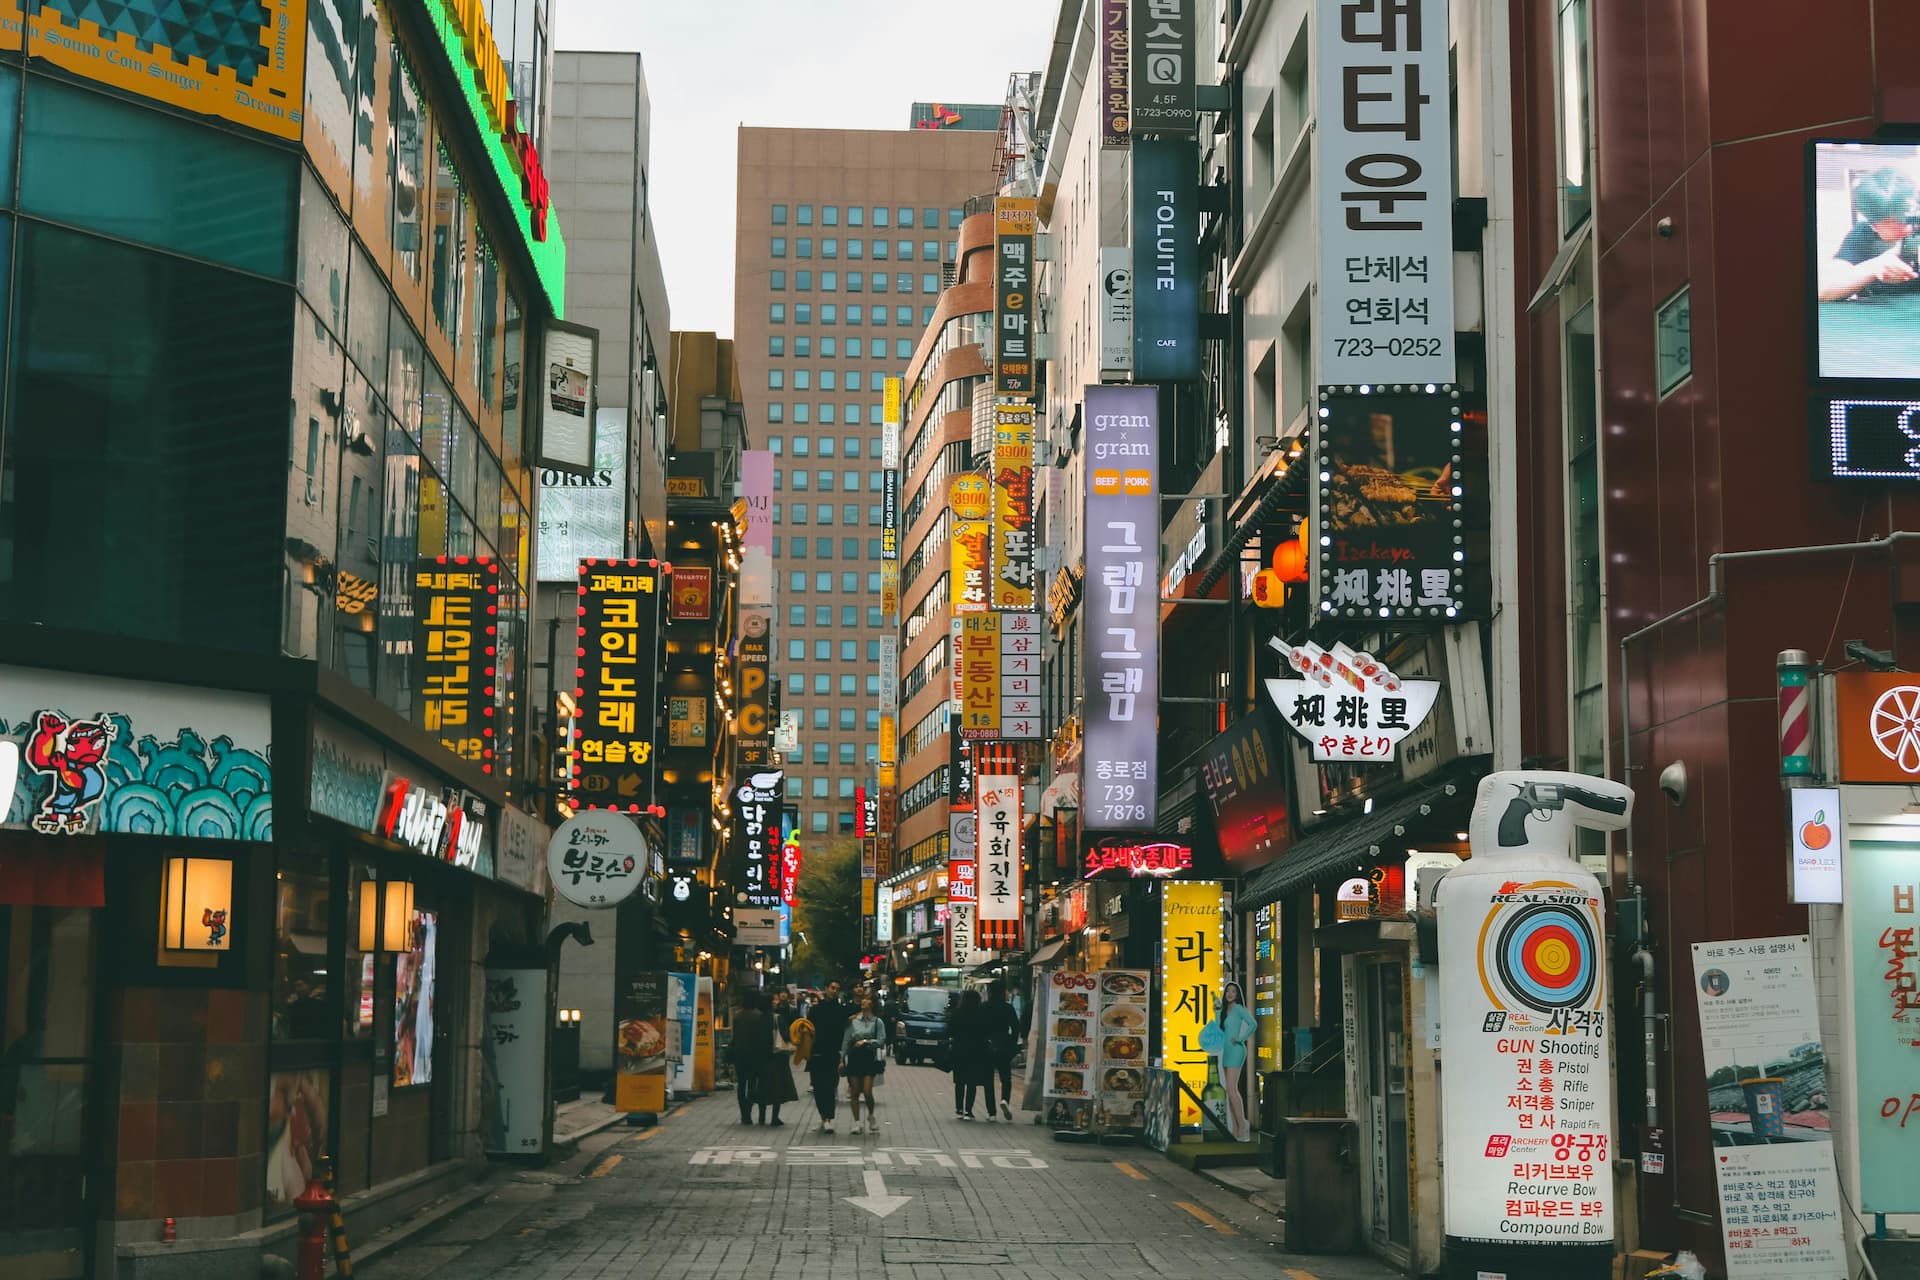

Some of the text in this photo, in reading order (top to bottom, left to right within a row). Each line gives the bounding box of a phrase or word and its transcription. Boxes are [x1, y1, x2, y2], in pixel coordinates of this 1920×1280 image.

[1156, 190, 1175, 290] FOLUITE
[1345, 256, 1428, 284] 단체석
[1345, 298, 1429, 325] 연회석
[1156, 339, 1177, 347] CAFE
[1334, 338, 1442, 357] 723-0252
[1095, 414, 1151, 431] gram
[998, 446, 1029, 457] 3900
[1095, 442, 1151, 459] gram
[1096, 477, 1149, 486] BEEF PORK
[954, 492, 986, 504] 3900
[590, 574, 654, 593] 고래고래
[1101, 521, 1143, 721] 그램그램
[598, 598, 639, 733] 코인노래
[741, 654, 768, 662] SPEED
[967, 635, 996, 709] 부동산
[582, 740, 652, 764] 연습장
[1319, 735, 1391, 756] やきとり
[1096, 761, 1147, 780] 종로점
[1104, 785, 1135, 801] 739
[1096, 805, 1146, 821] -7878
[989, 810, 1012, 904] 육회지존
[1170, 902, 1219, 916] Private
[954, 906, 969, 964] 황소곱창
[1707, 943, 1796, 958] 바로 주스 사용 설명서
[1508, 1013, 1530, 1021] REAL
[1545, 1008, 1605, 1038] 사격장
[1508, 1024, 1545, 1032] Reaction
[1496, 1038, 1600, 1058] GUN Shooting
[1558, 1061, 1589, 1074] Pistol
[1563, 1080, 1589, 1092] Rifle
[1507, 1095, 1594, 1113] 저격총 Sniper
[1560, 1119, 1586, 1132] Rapid
[1511, 1145, 1537, 1153] Center
[1550, 1133, 1608, 1162] 양궁장
[1514, 1163, 1594, 1181] 리커브보우
[1508, 1181, 1597, 1196] Recurve Bow
[1723, 1178, 1816, 1192] #바로주스 먹고 힘내서
[1724, 1193, 1741, 1203] 바로
[1758, 1190, 1784, 1200] 합격해
[1788, 1189, 1815, 1200] 친구야
[1505, 1199, 1604, 1218] 컴파운드 보우
[1726, 1202, 1791, 1214] #바로 주스 먹고
[1500, 1220, 1605, 1236] Compound Bow
[1727, 1215, 1750, 1225] #바로
[1728, 1226, 1799, 1238] #바로주스 #먹고
[1791, 1236, 1811, 1246] 하자
